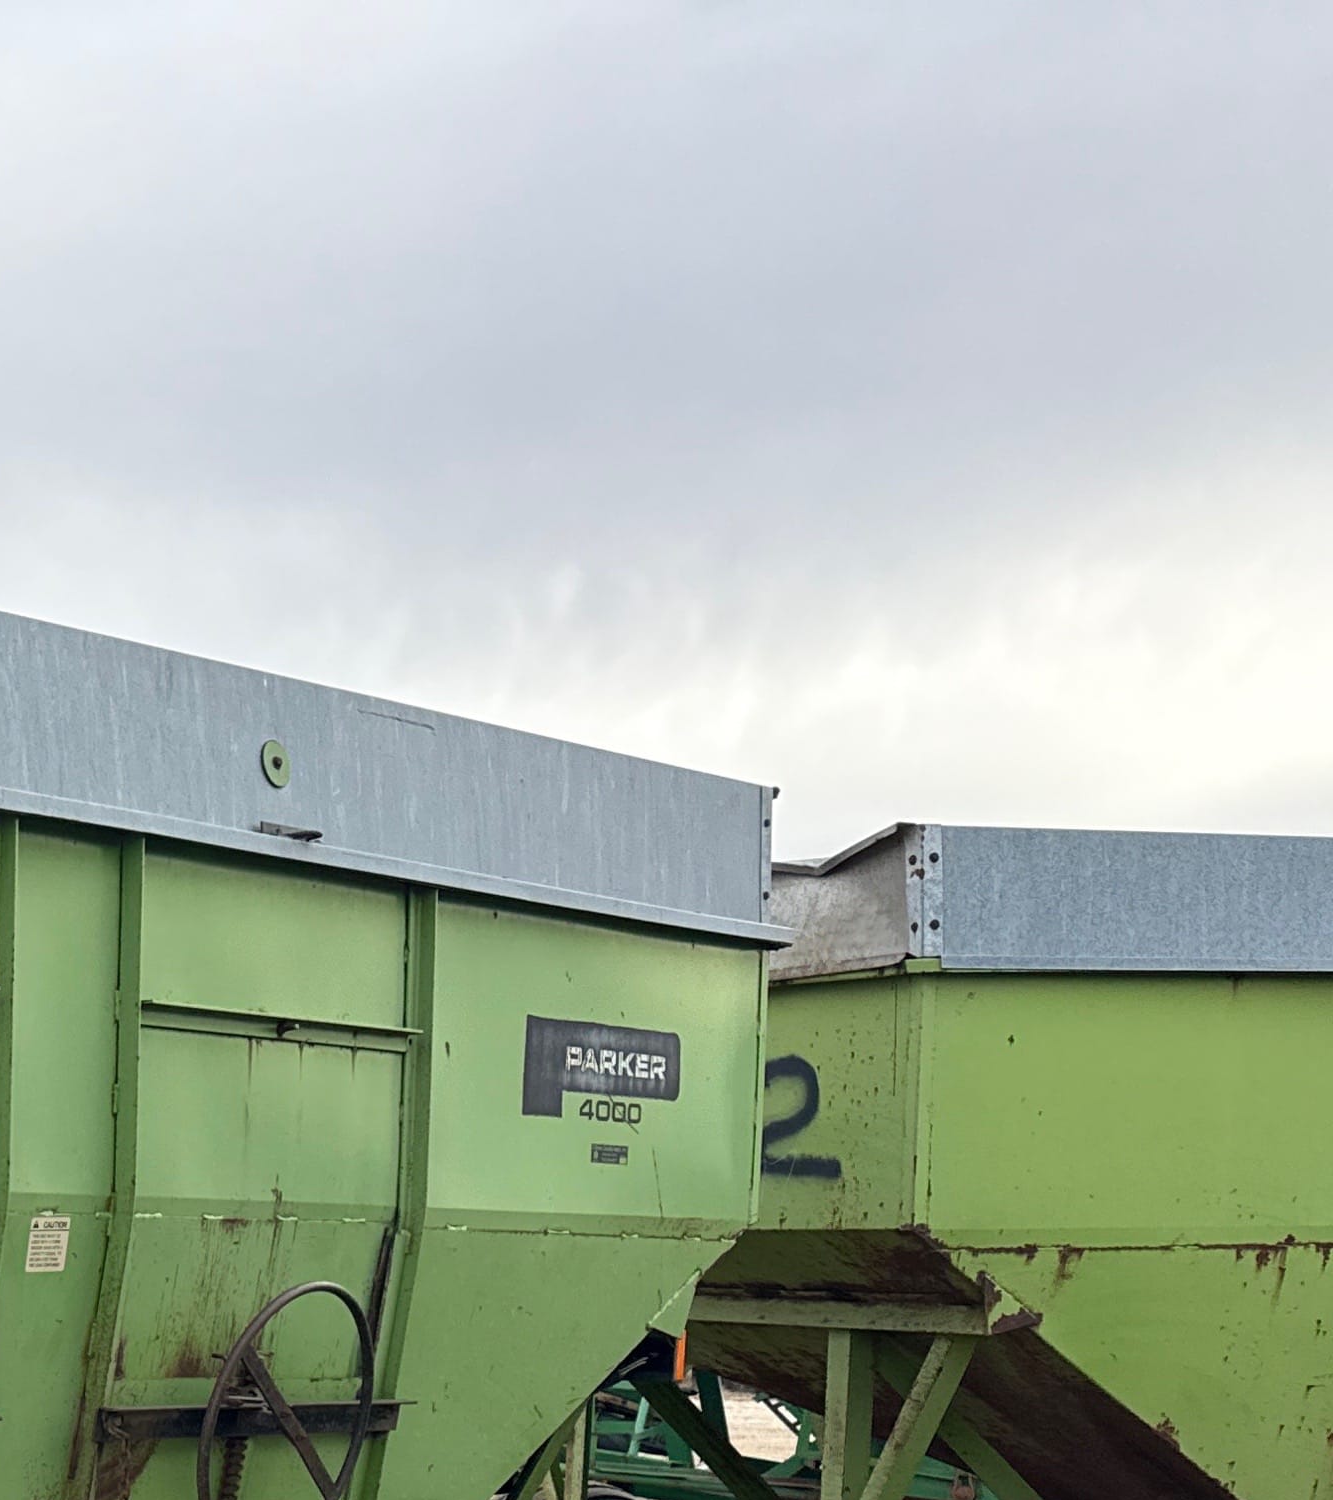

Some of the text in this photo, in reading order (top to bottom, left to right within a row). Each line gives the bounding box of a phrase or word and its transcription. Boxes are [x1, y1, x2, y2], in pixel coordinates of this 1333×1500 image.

[566, 1045, 667, 1080] PARKER
[579, 1099, 641, 1124] 4000
[761, 1054, 842, 1180] 2
[43, 1221, 68, 1229] CAUTION
